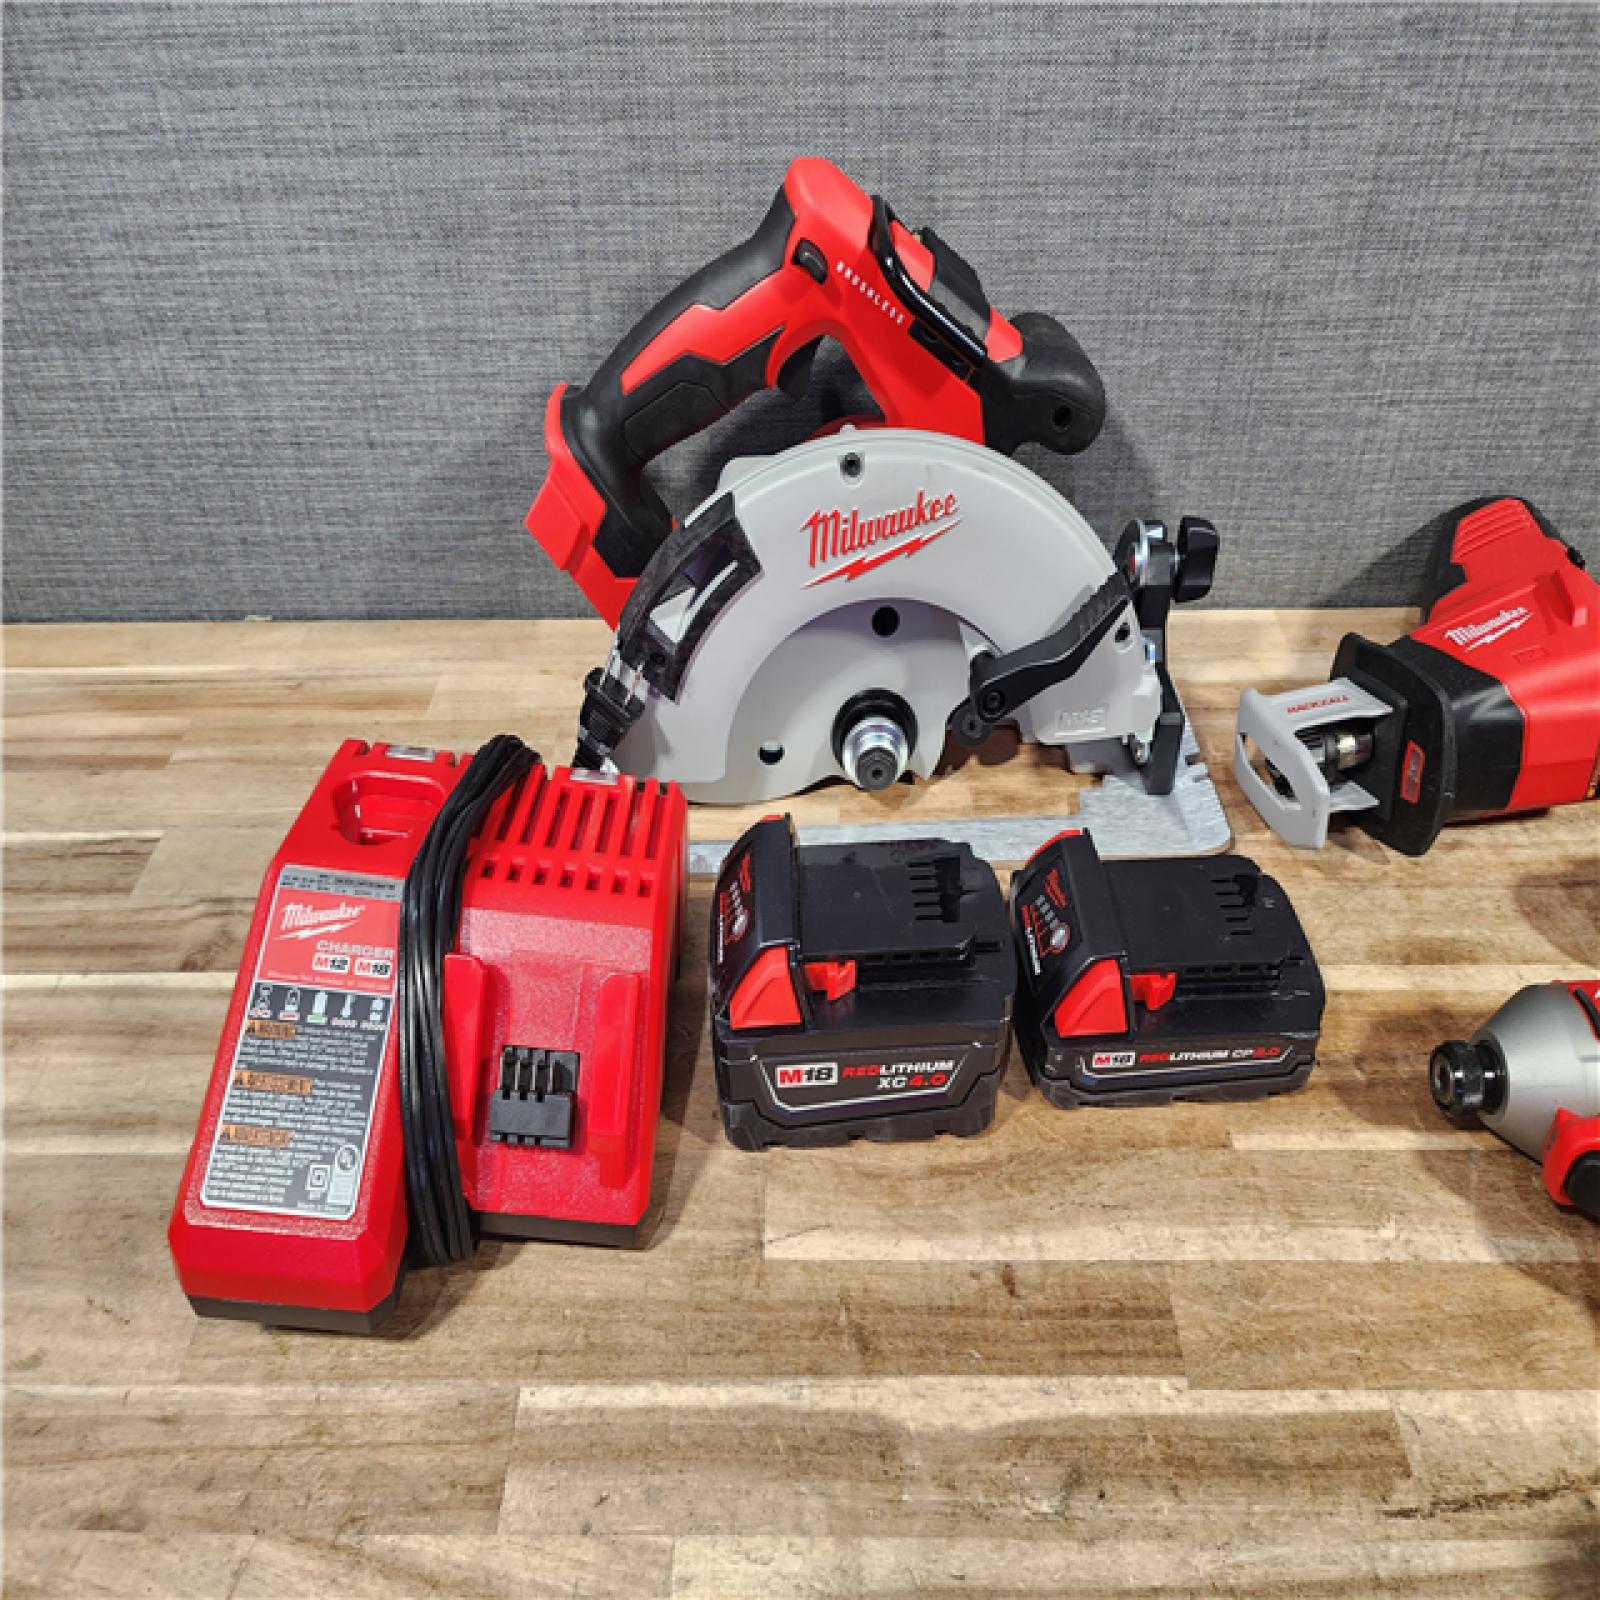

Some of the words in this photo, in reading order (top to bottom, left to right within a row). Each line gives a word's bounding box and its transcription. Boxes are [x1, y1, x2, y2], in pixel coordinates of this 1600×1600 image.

[836, 260, 904, 325] BRUSHLESS
[799, 489, 959, 568] Milwaukee
[779, 1066, 833, 1085] M18
